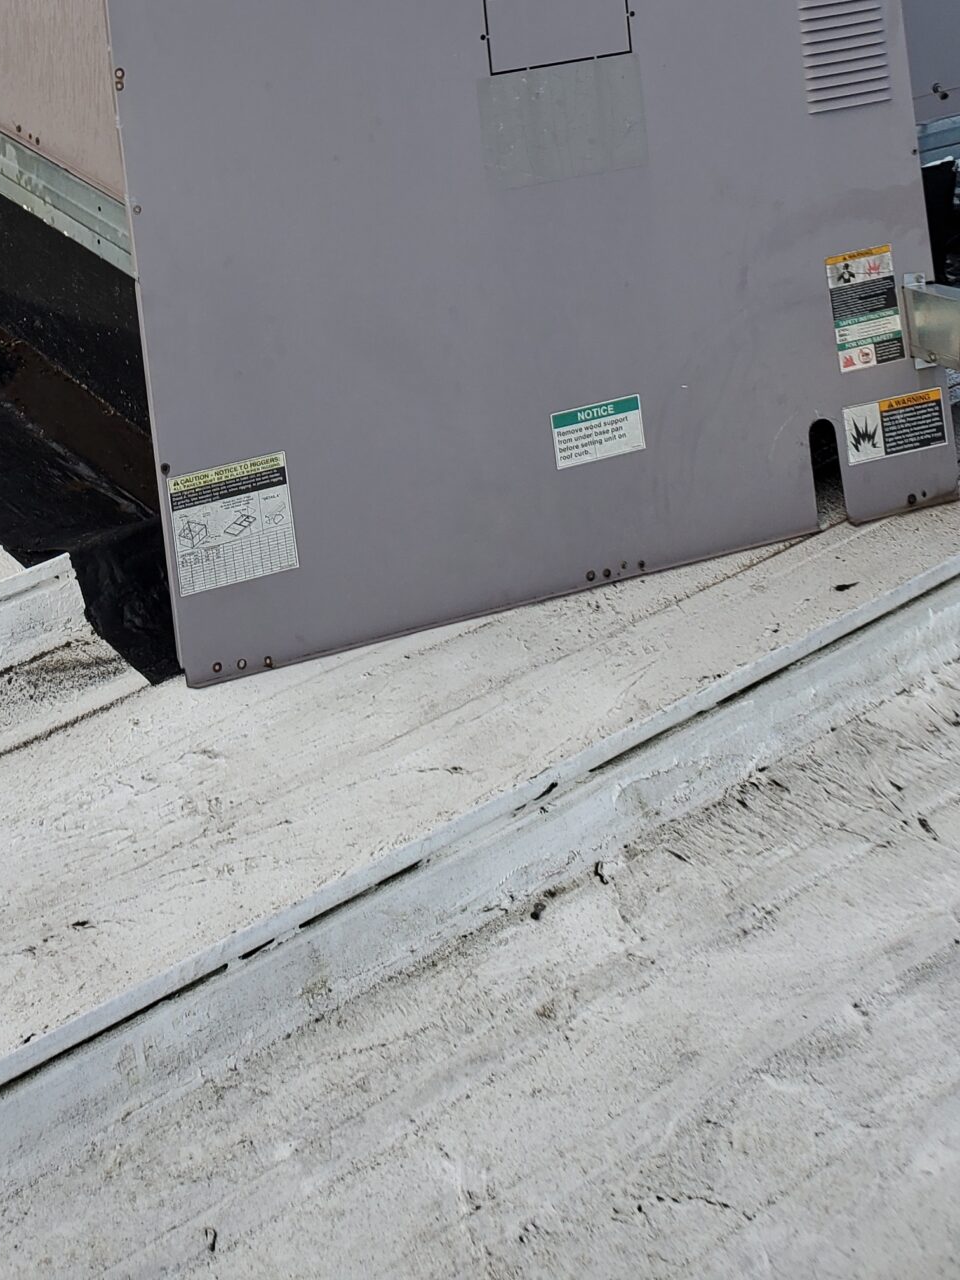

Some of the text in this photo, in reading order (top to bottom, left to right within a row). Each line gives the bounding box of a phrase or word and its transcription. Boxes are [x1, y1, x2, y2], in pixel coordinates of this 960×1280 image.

[839, 310, 894, 327] SAFETY INSTRUCTIONS
[845, 333, 894, 349] FOR YOUR SAFETY
[894, 393, 931, 406] WARNING
[577, 404, 615, 421] NOTICE
[557, 416, 628, 437] Remove wood support
[557, 426, 623, 445] from under base pan
[558, 444, 579, 453] before
[580, 439, 603, 449] setting
[604, 435, 617, 443] unit
[559, 449, 592, 461] roof curb.
[180, 473, 209, 485] CAUTION
[214, 466, 238, 477] NOTICE
[239, 463, 249, 471] TO
